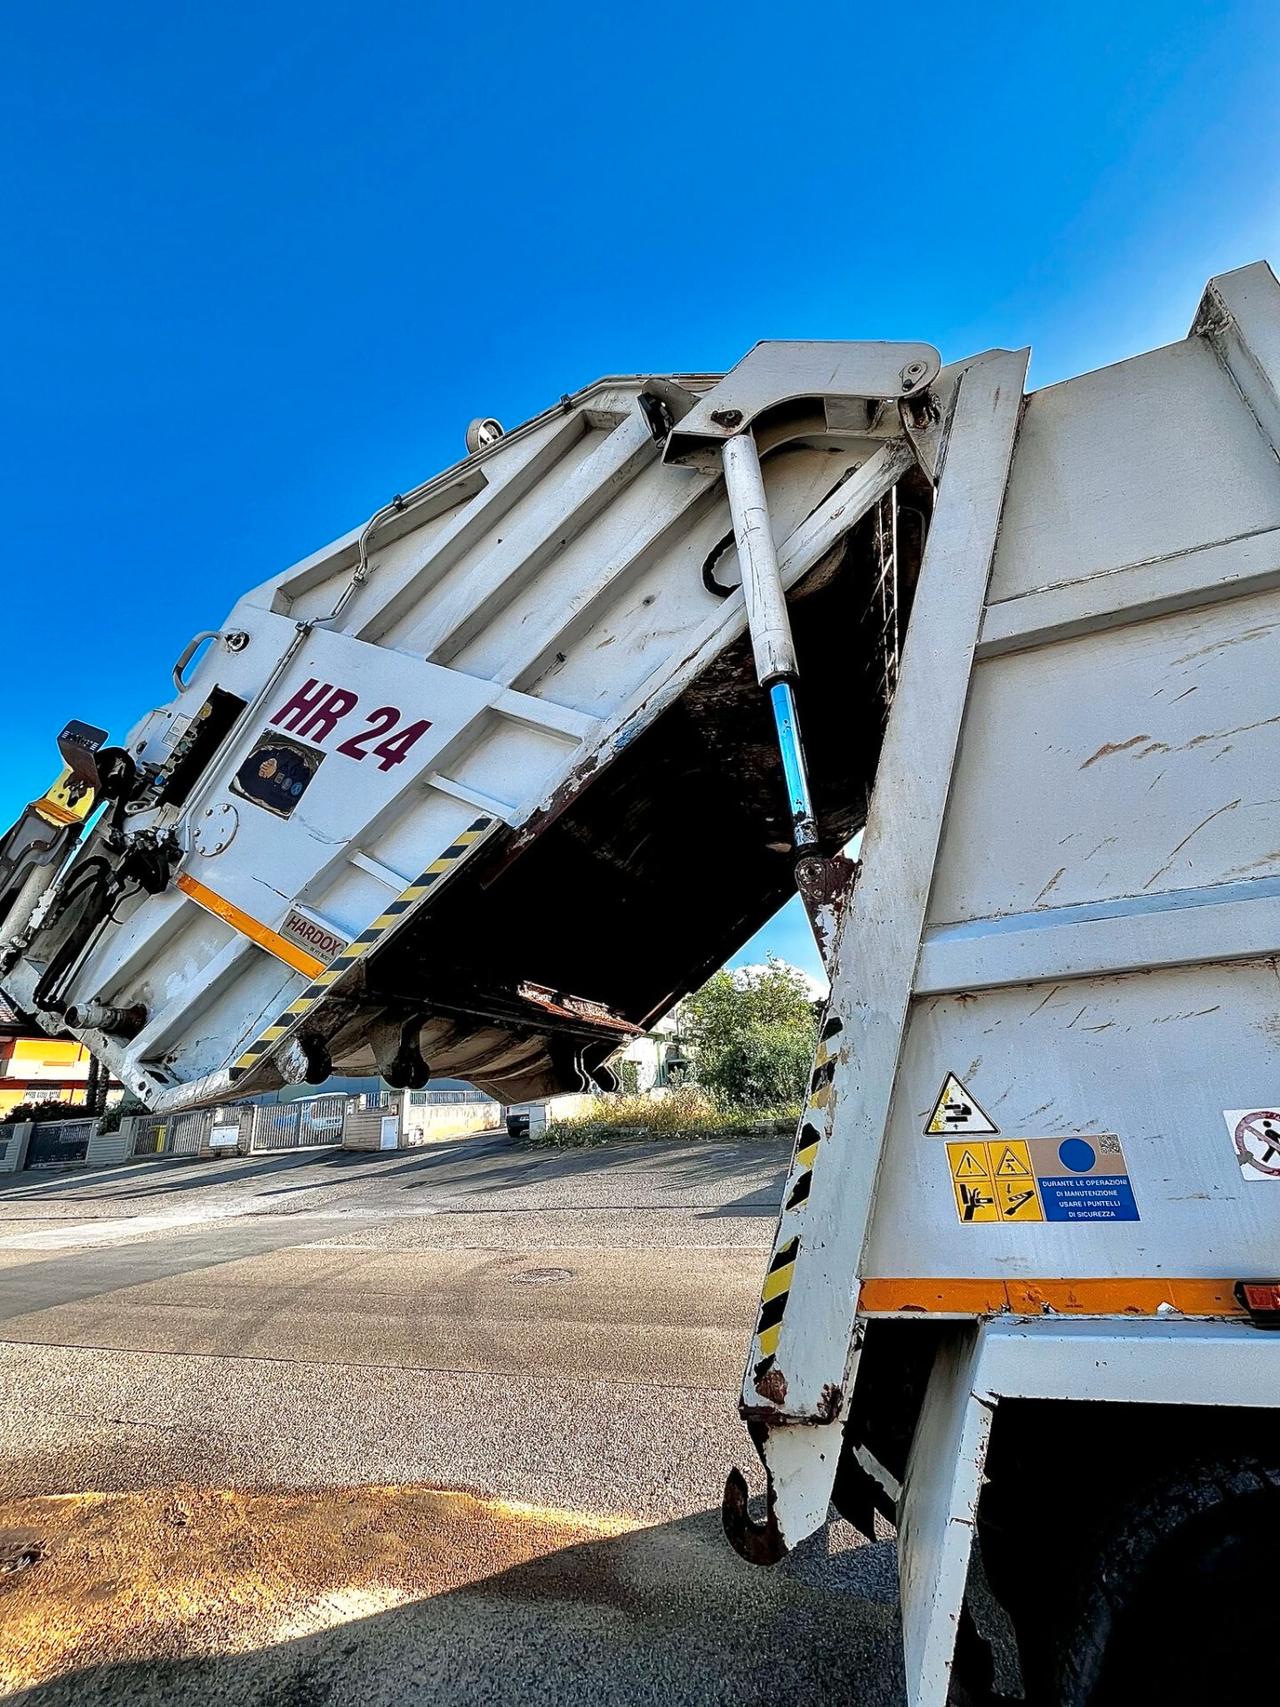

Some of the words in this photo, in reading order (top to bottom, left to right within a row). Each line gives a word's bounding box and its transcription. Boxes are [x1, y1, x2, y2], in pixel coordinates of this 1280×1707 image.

[268, 678, 359, 744] HR
[336, 706, 433, 773] 24
[286, 915, 342, 956] HARDOX
[1085, 1178, 1128, 1186] OPERAZIONI
